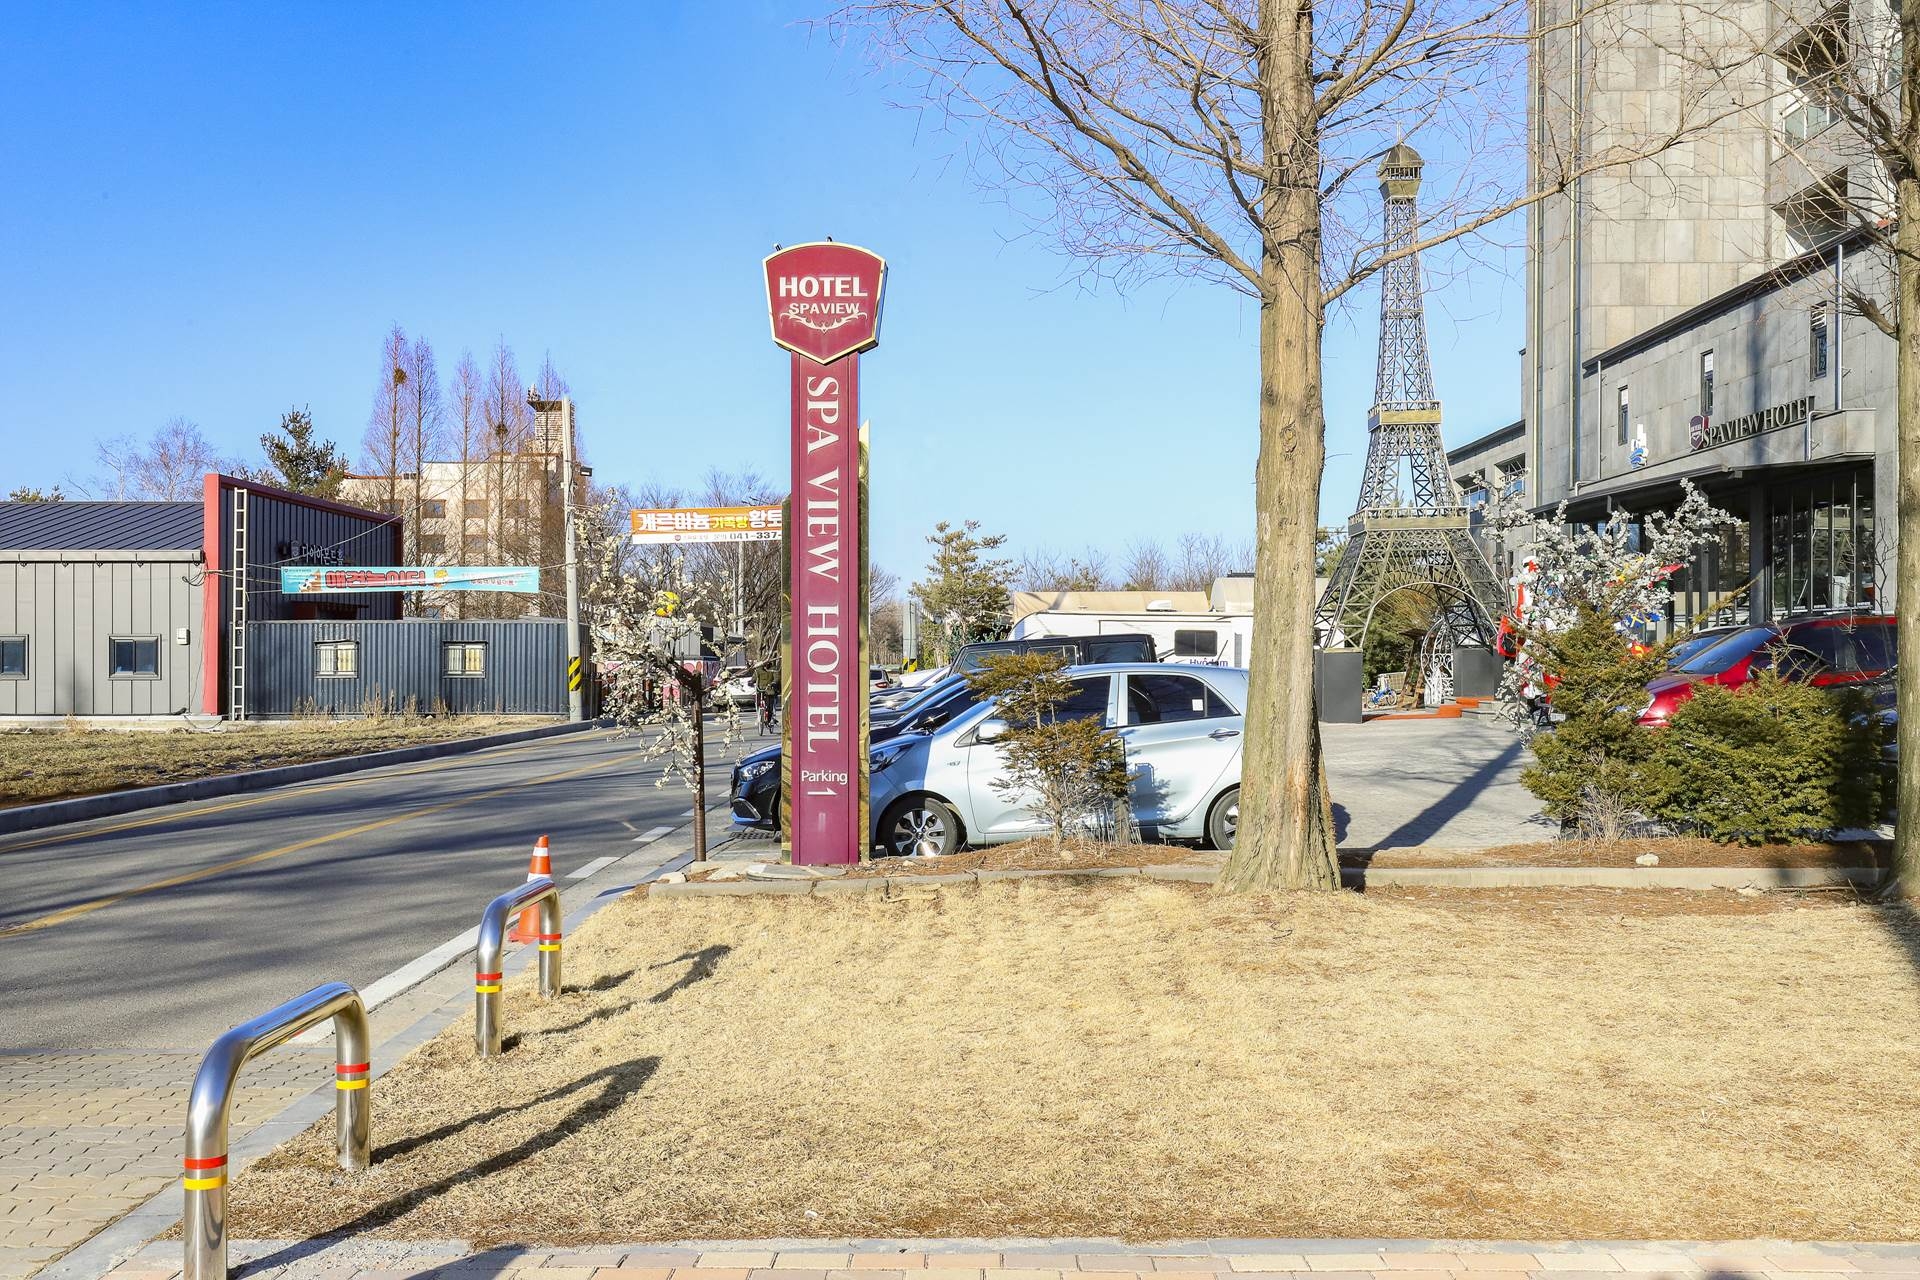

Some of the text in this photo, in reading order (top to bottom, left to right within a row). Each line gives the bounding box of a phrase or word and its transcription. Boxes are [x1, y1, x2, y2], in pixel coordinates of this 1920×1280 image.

[779, 276, 868, 298] HOTEL
[788, 302, 861, 315] SPAVIEW
[806, 376, 840, 753] SPA VIEW HOTEL
[325, 570, 426, 589] 애견놀이터
[801, 769, 848, 785] Parking
